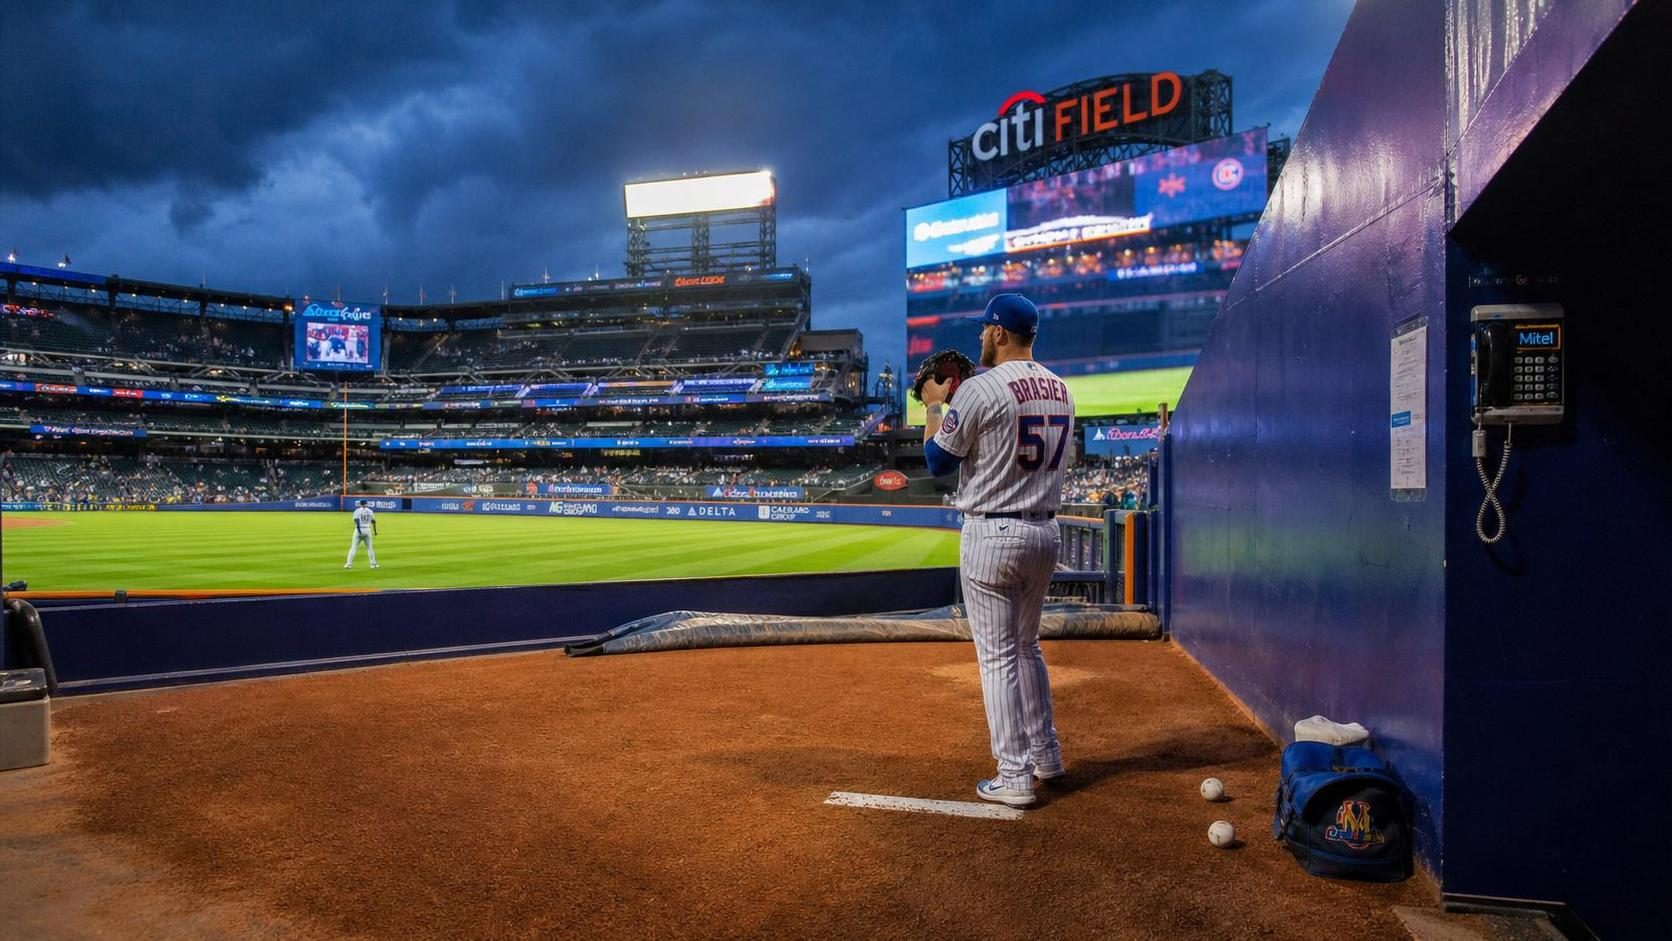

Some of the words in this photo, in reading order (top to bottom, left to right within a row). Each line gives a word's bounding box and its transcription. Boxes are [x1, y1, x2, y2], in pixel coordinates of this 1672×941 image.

[972, 101, 1044, 161] citi
[1055, 72, 1182, 142] FIELD
[1519, 332, 1554, 345] Mitel
[1008, 377, 1068, 405] BRASIER
[1017, 413, 1072, 472] 57
[699, 506, 736, 517] DELTA
